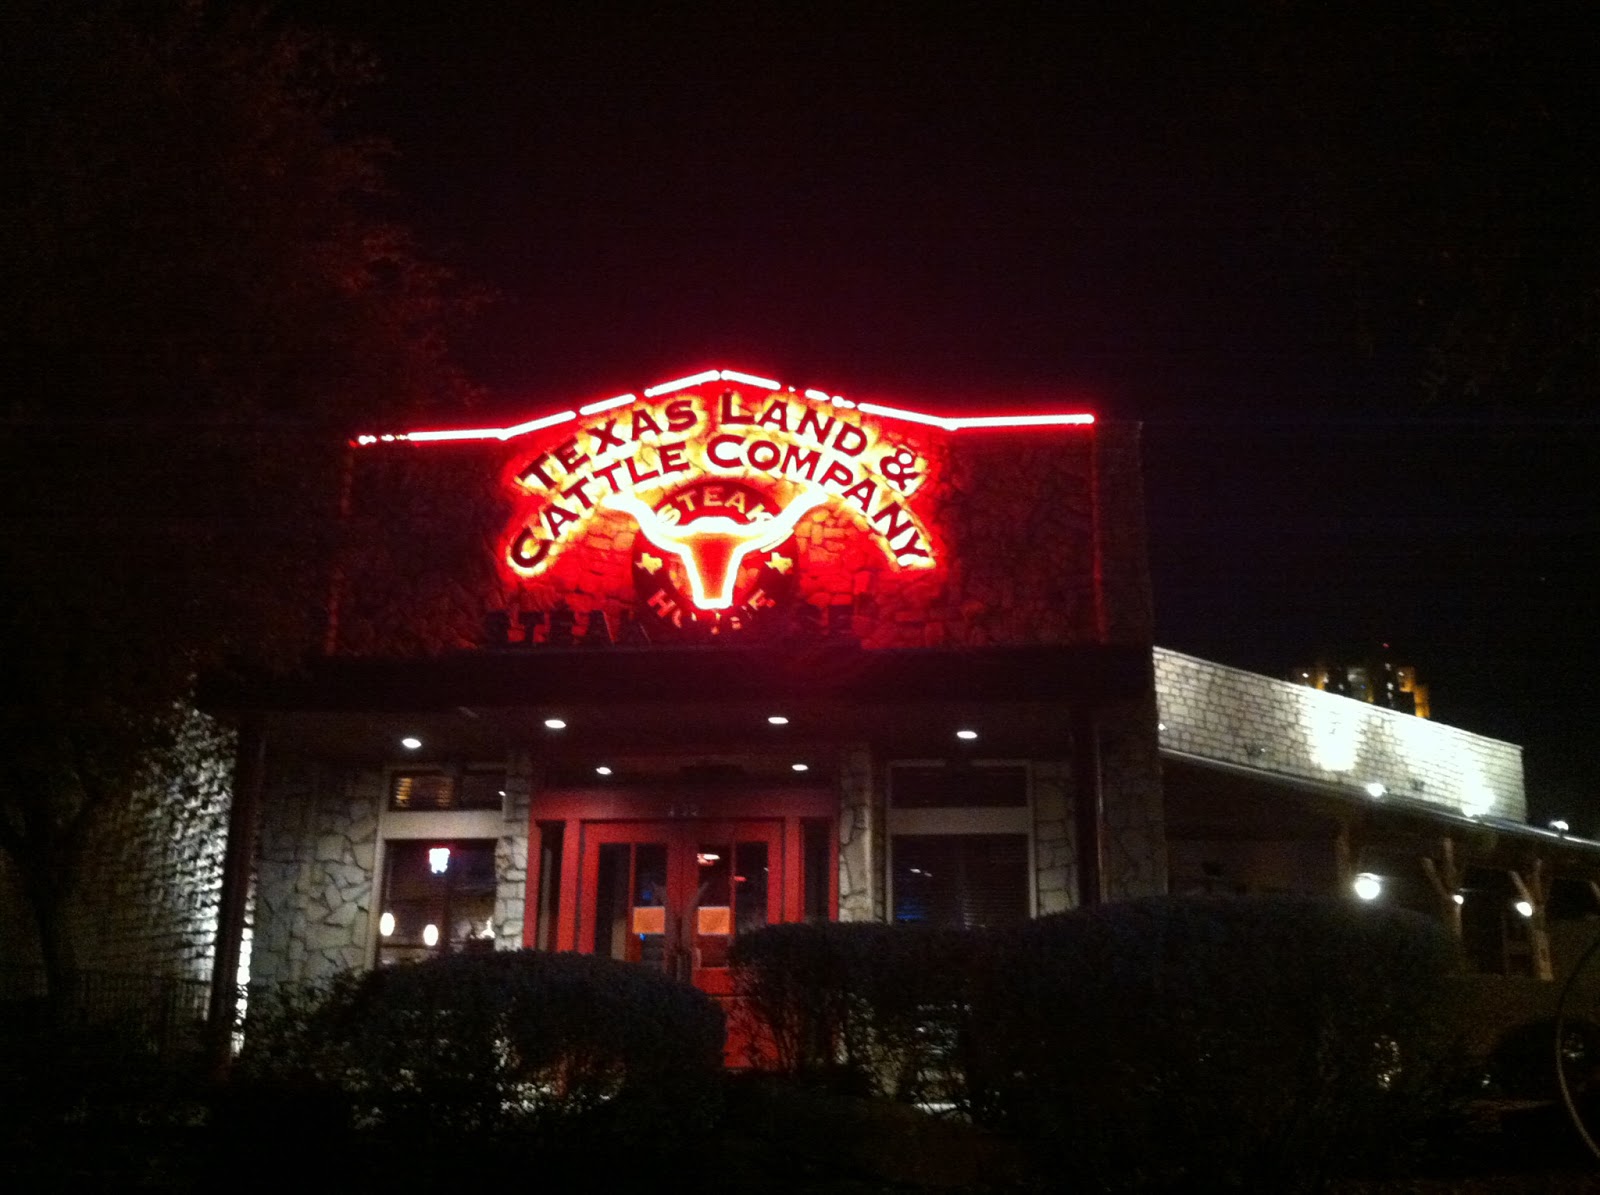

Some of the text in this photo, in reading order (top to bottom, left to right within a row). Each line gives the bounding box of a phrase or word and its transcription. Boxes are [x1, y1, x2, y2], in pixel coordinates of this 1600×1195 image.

[516, 392, 921, 491] TEXAS LAND &
[510, 434, 930, 568] CATTLE COMPANY
